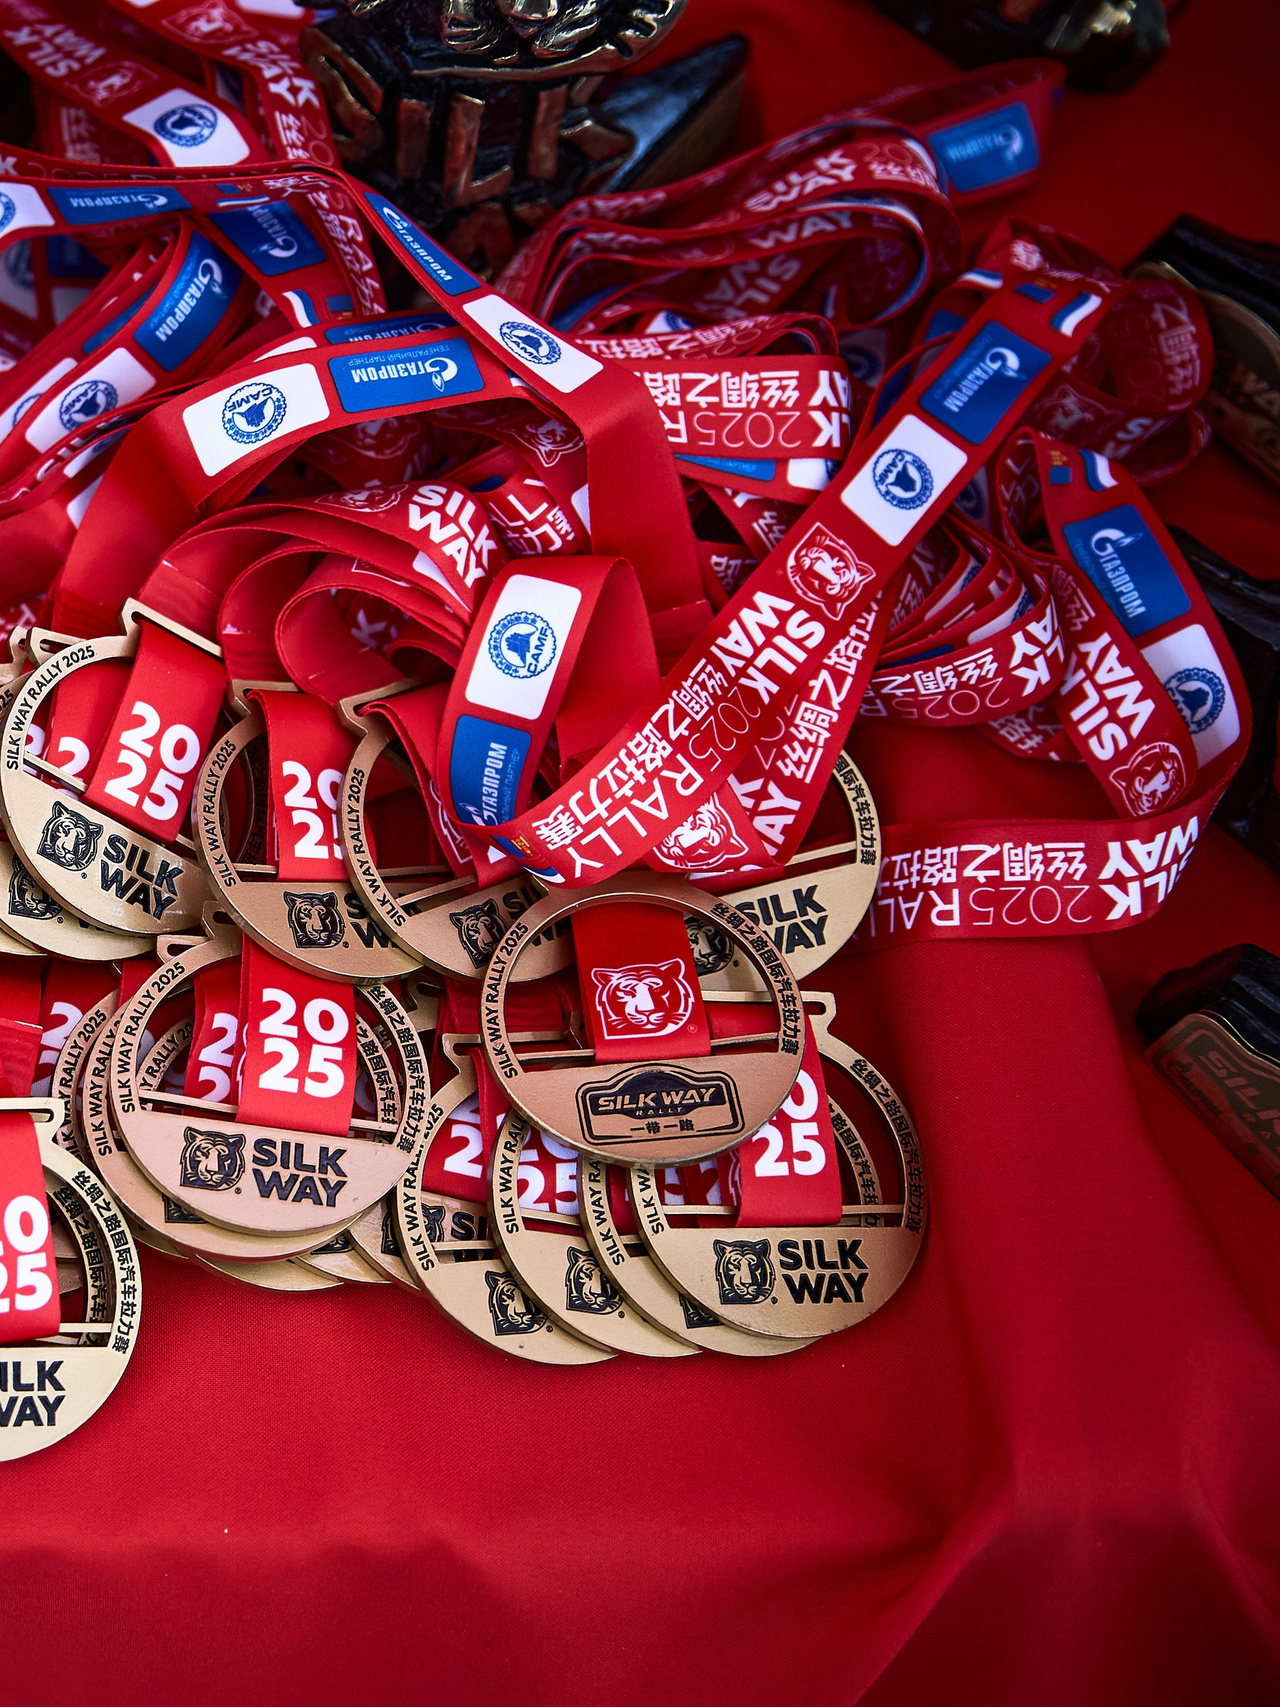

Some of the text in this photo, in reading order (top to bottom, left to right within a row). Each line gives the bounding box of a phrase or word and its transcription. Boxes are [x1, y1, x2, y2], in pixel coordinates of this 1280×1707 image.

[6, 26, 80, 78] SILK
[36, 22, 106, 64] WAY
[250, 39, 321, 109] SILK
[223, 44, 297, 106] WAY
[398, 225, 453, 282] ГАЗПРОМ
[156, 277, 207, 343] ГАЗПРОМ
[351, 363, 426, 384] ГАЗПРОМ
[502, 332, 541, 364] CAMF
[228, 387, 273, 412] CAMF
[694, 411, 802, 448] 2025
[408, 504, 487, 589] WAY
[414, 485, 497, 571] SILK
[1100, 550, 1147, 618] ГАЗПРОМ
[527, 626, 549, 675] CAMF
[709, 590, 795, 680] WAY
[737, 609, 825, 705] SILK
[10, 645, 96, 737] WAY RALLY 2025
[892, 677, 1010, 720] 2025
[1060, 652, 1128, 761] SILK
[1078, 631, 1156, 739] WAY
[120, 701, 201, 774] 20
[104, 749, 184, 822] 25
[482, 742, 508, 815] ГАЗПРОМ
[574, 686, 762, 879] 2025 RALLY
[203, 740, 237, 888] SILK WAY RALLY 2025
[103, 833, 185, 897] SILK
[348, 767, 406, 928] SILK RALLY 2025
[1098, 815, 1200, 879] WAY
[100, 859, 176, 921] WAY
[742, 884, 828, 933] SILK
[969, 884, 1093, 926] 2025
[485, 954, 508, 1004] RALLY
[499, 922, 530, 957] 2025
[77, 1008, 108, 1042] 2025
[125, 961, 186, 1038] RALLY 2025
[259, 987, 350, 1046] 20
[258, 1037, 345, 1099] 25
[597, 1086, 718, 1112] SILK WAY
[629, 1119, 695, 1135] 一带一路
[635, 1106, 684, 1116] RALLY
[252, 1137, 348, 1177] SILK
[752, 1121, 827, 1178] 25
[252, 1168, 348, 1208] WAY
[499, 1154, 520, 1235] SILK WAY
[777, 1239, 869, 1271] SILK
[781, 1273, 869, 1305] WAY
